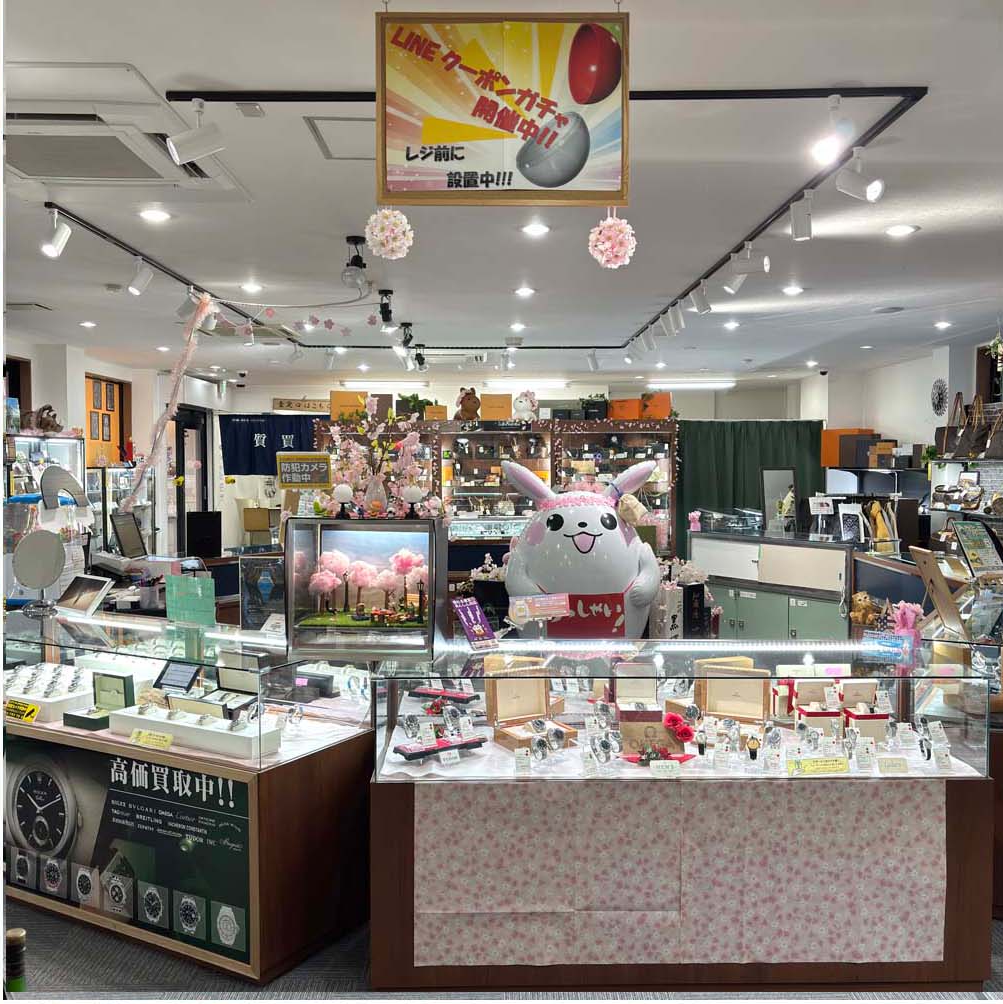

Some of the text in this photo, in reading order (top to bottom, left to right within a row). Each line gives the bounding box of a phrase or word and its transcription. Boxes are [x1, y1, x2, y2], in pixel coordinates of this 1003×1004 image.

[390, 26, 441, 62] LINE
[441, 50, 570, 129] クーポンガチャ
[405, 146, 465, 162] レジ前に
[281, 462, 328, 472] 防犯カメラ
